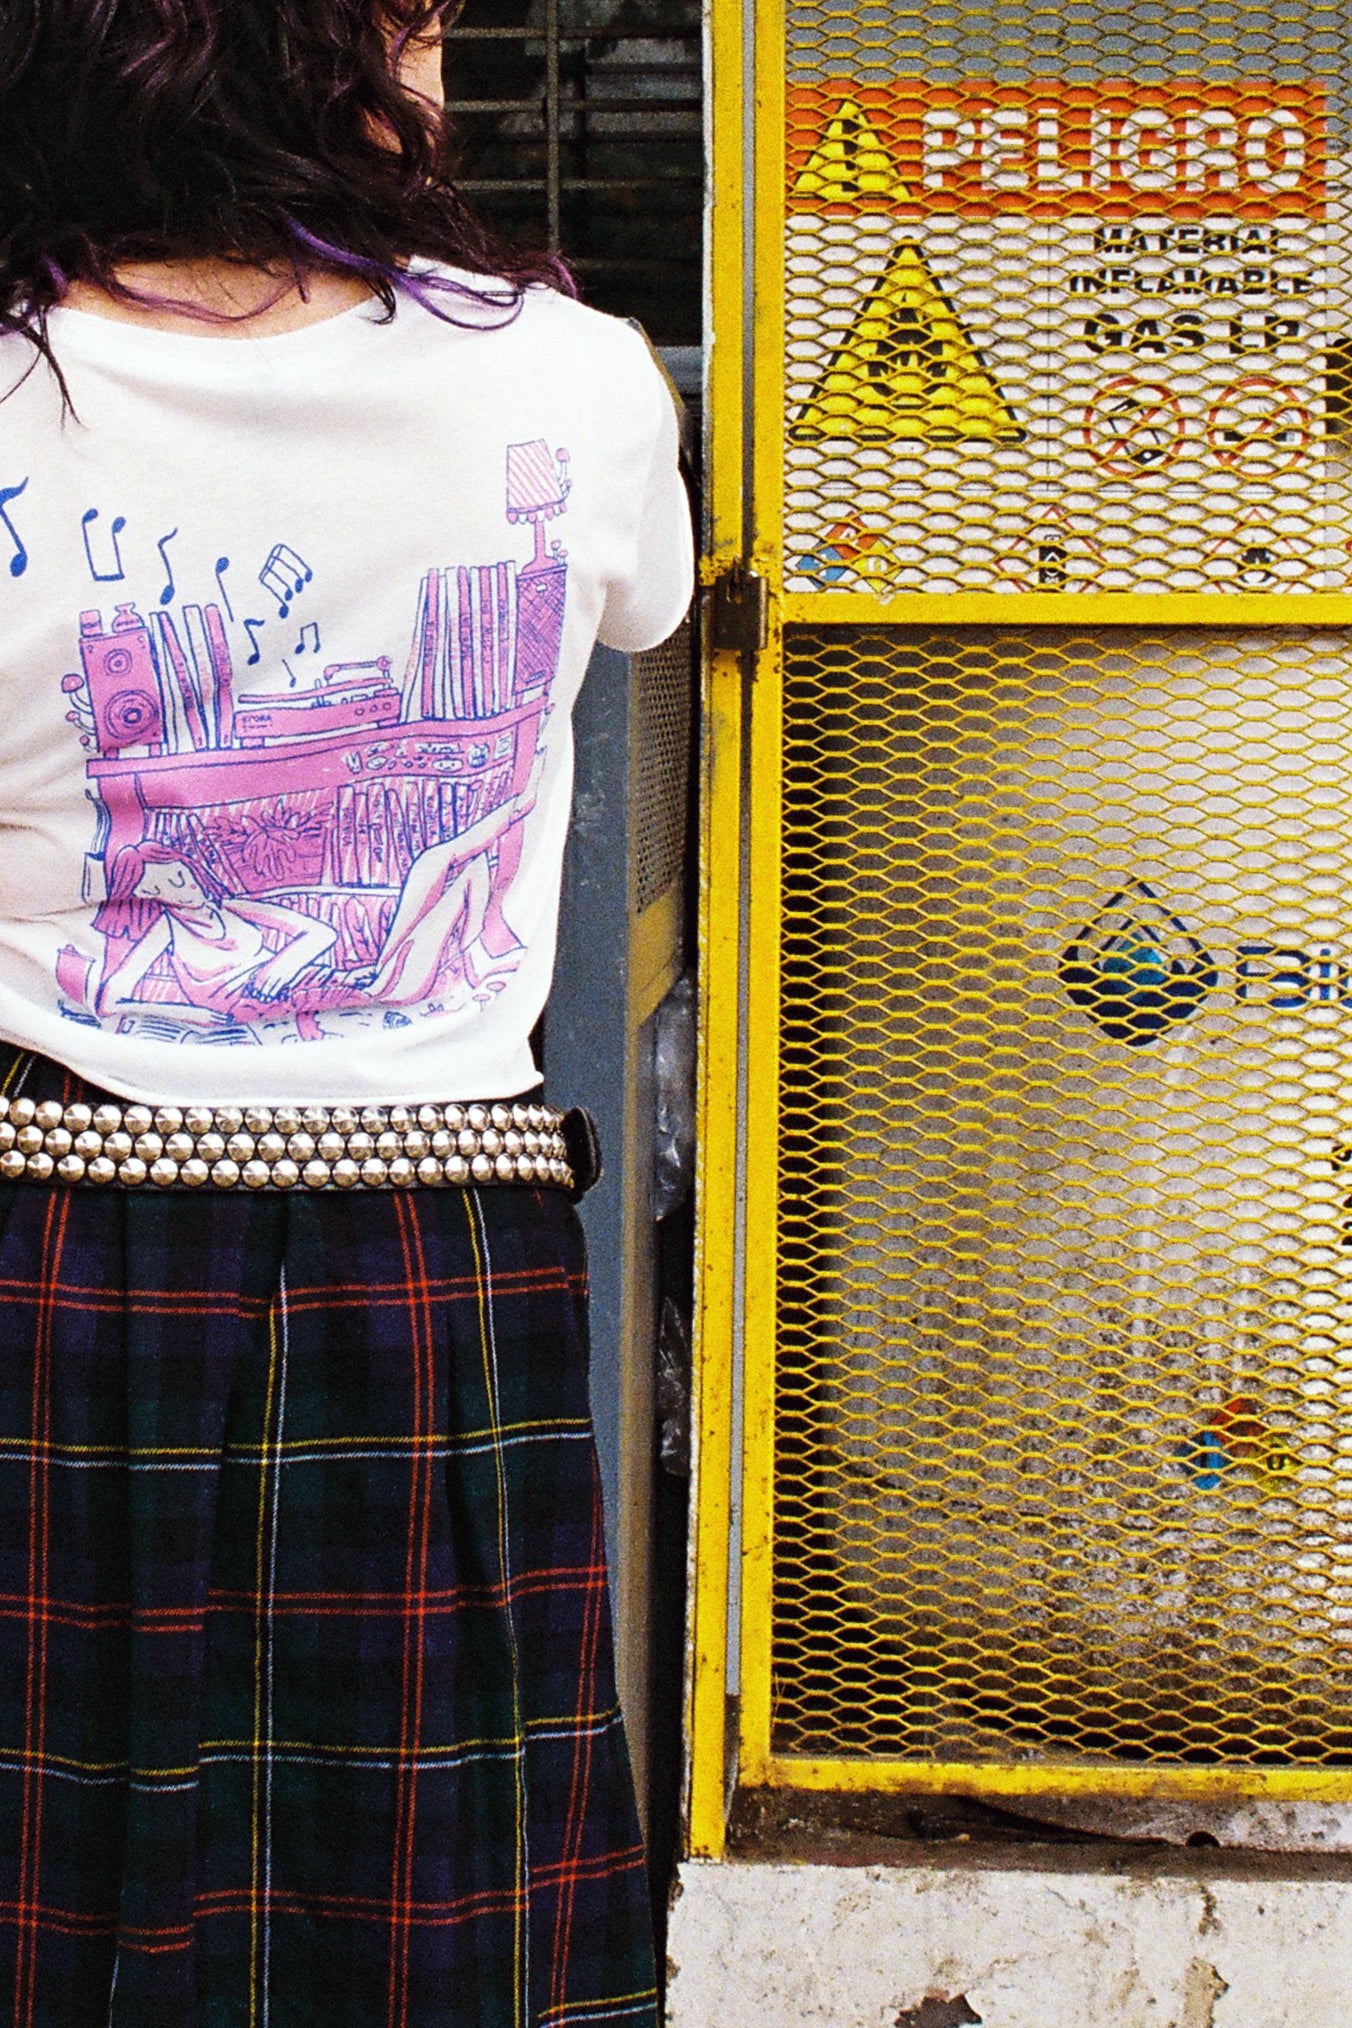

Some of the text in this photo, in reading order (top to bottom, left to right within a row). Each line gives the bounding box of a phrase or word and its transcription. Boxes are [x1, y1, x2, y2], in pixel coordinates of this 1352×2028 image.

[922, 108, 1305, 193] PELIGRO
[1094, 228, 1292, 254] MATERIAL
[1070, 269, 1312, 294] INFLAMABLE
[1084, 314, 1300, 354] GAS LP
[1236, 946, 1352, 1010] Bi
